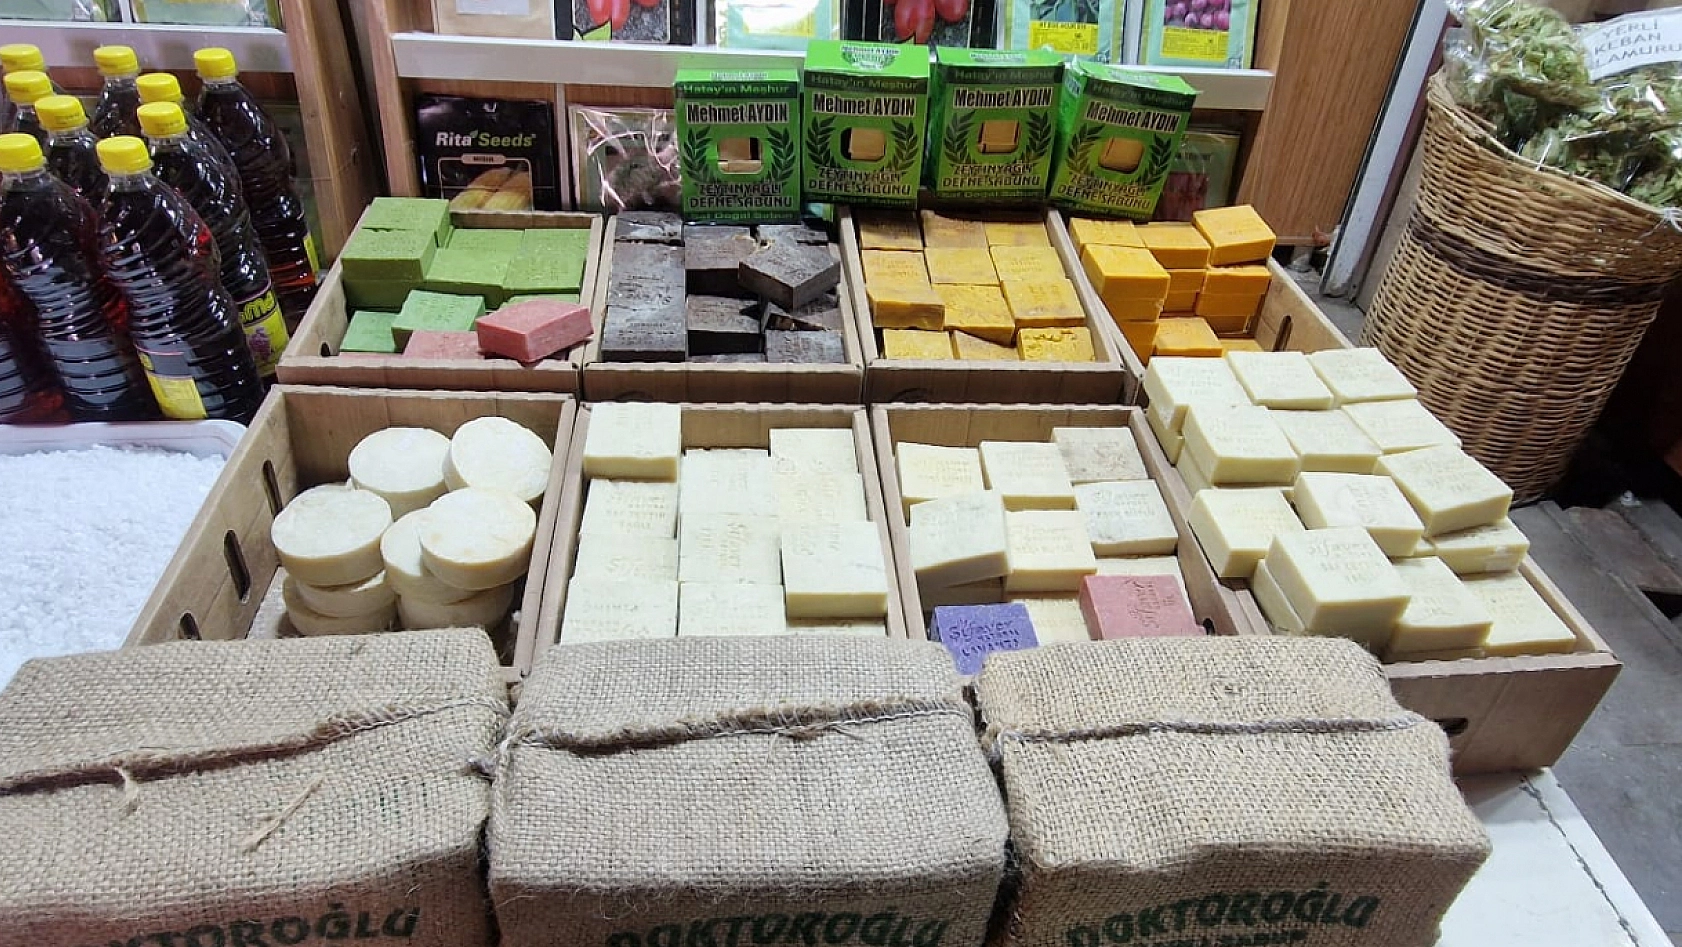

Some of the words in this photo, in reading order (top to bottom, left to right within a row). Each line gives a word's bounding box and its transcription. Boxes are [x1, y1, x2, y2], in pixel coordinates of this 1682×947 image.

[813, 93, 870, 114] Mehmet
[873, 97, 915, 116] AYDIN
[955, 88, 1010, 107] Mehmet
[1012, 88, 1052, 106] AYDIN
[687, 103, 745, 123] Mehmet
[747, 103, 788, 122] AYDIN
[1086, 100, 1141, 127] Mehmet
[1140, 110, 1180, 132] AYDIN
[435, 131, 472, 147] Rita
[478, 132, 532, 147] Seeds
[809, 180, 852, 193] DEFNE
[943, 177, 983, 187] DEFNE
[690, 197, 731, 208] DEFNE
[738, 197, 792, 208] SABUNU
